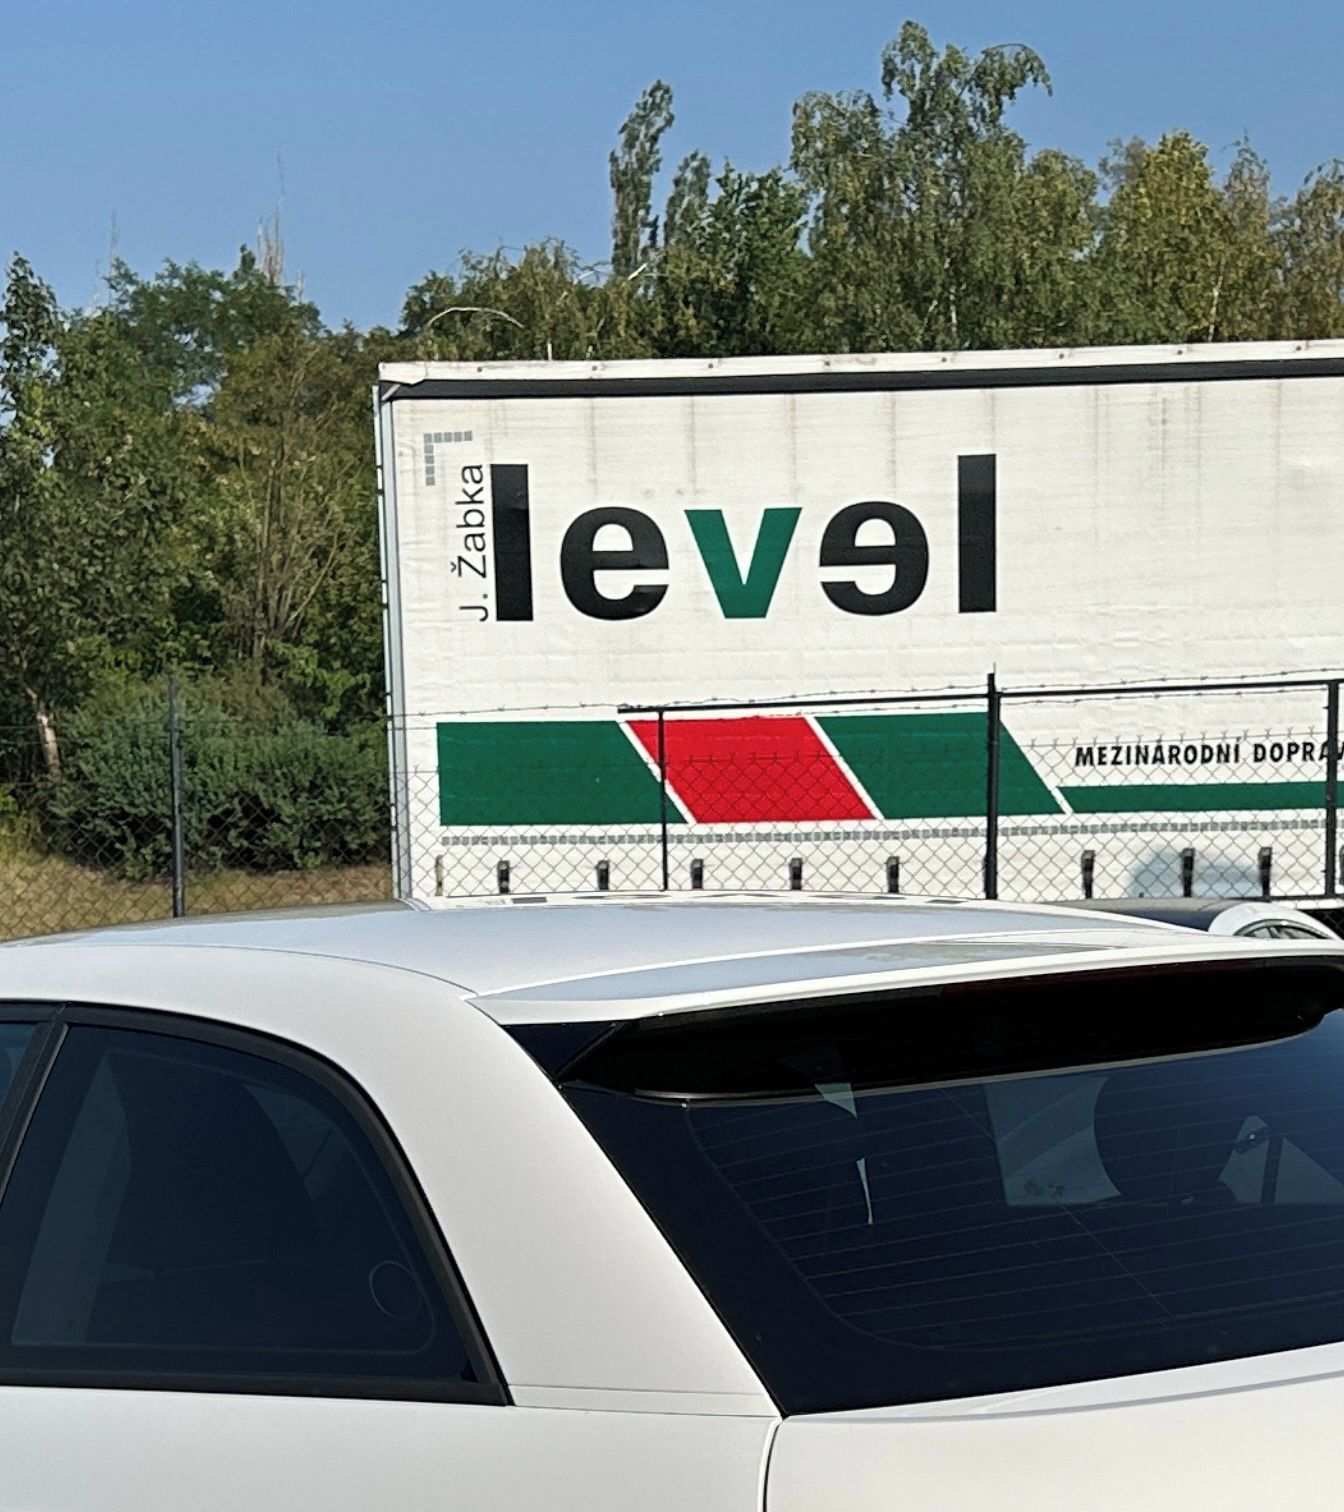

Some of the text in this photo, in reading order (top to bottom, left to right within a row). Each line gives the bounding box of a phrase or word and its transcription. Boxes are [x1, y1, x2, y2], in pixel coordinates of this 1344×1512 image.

[450, 464, 489, 622] J. Žabka
[490, 454, 997, 622] level
[1074, 736, 1242, 767] MEZINÁRODNÍ
